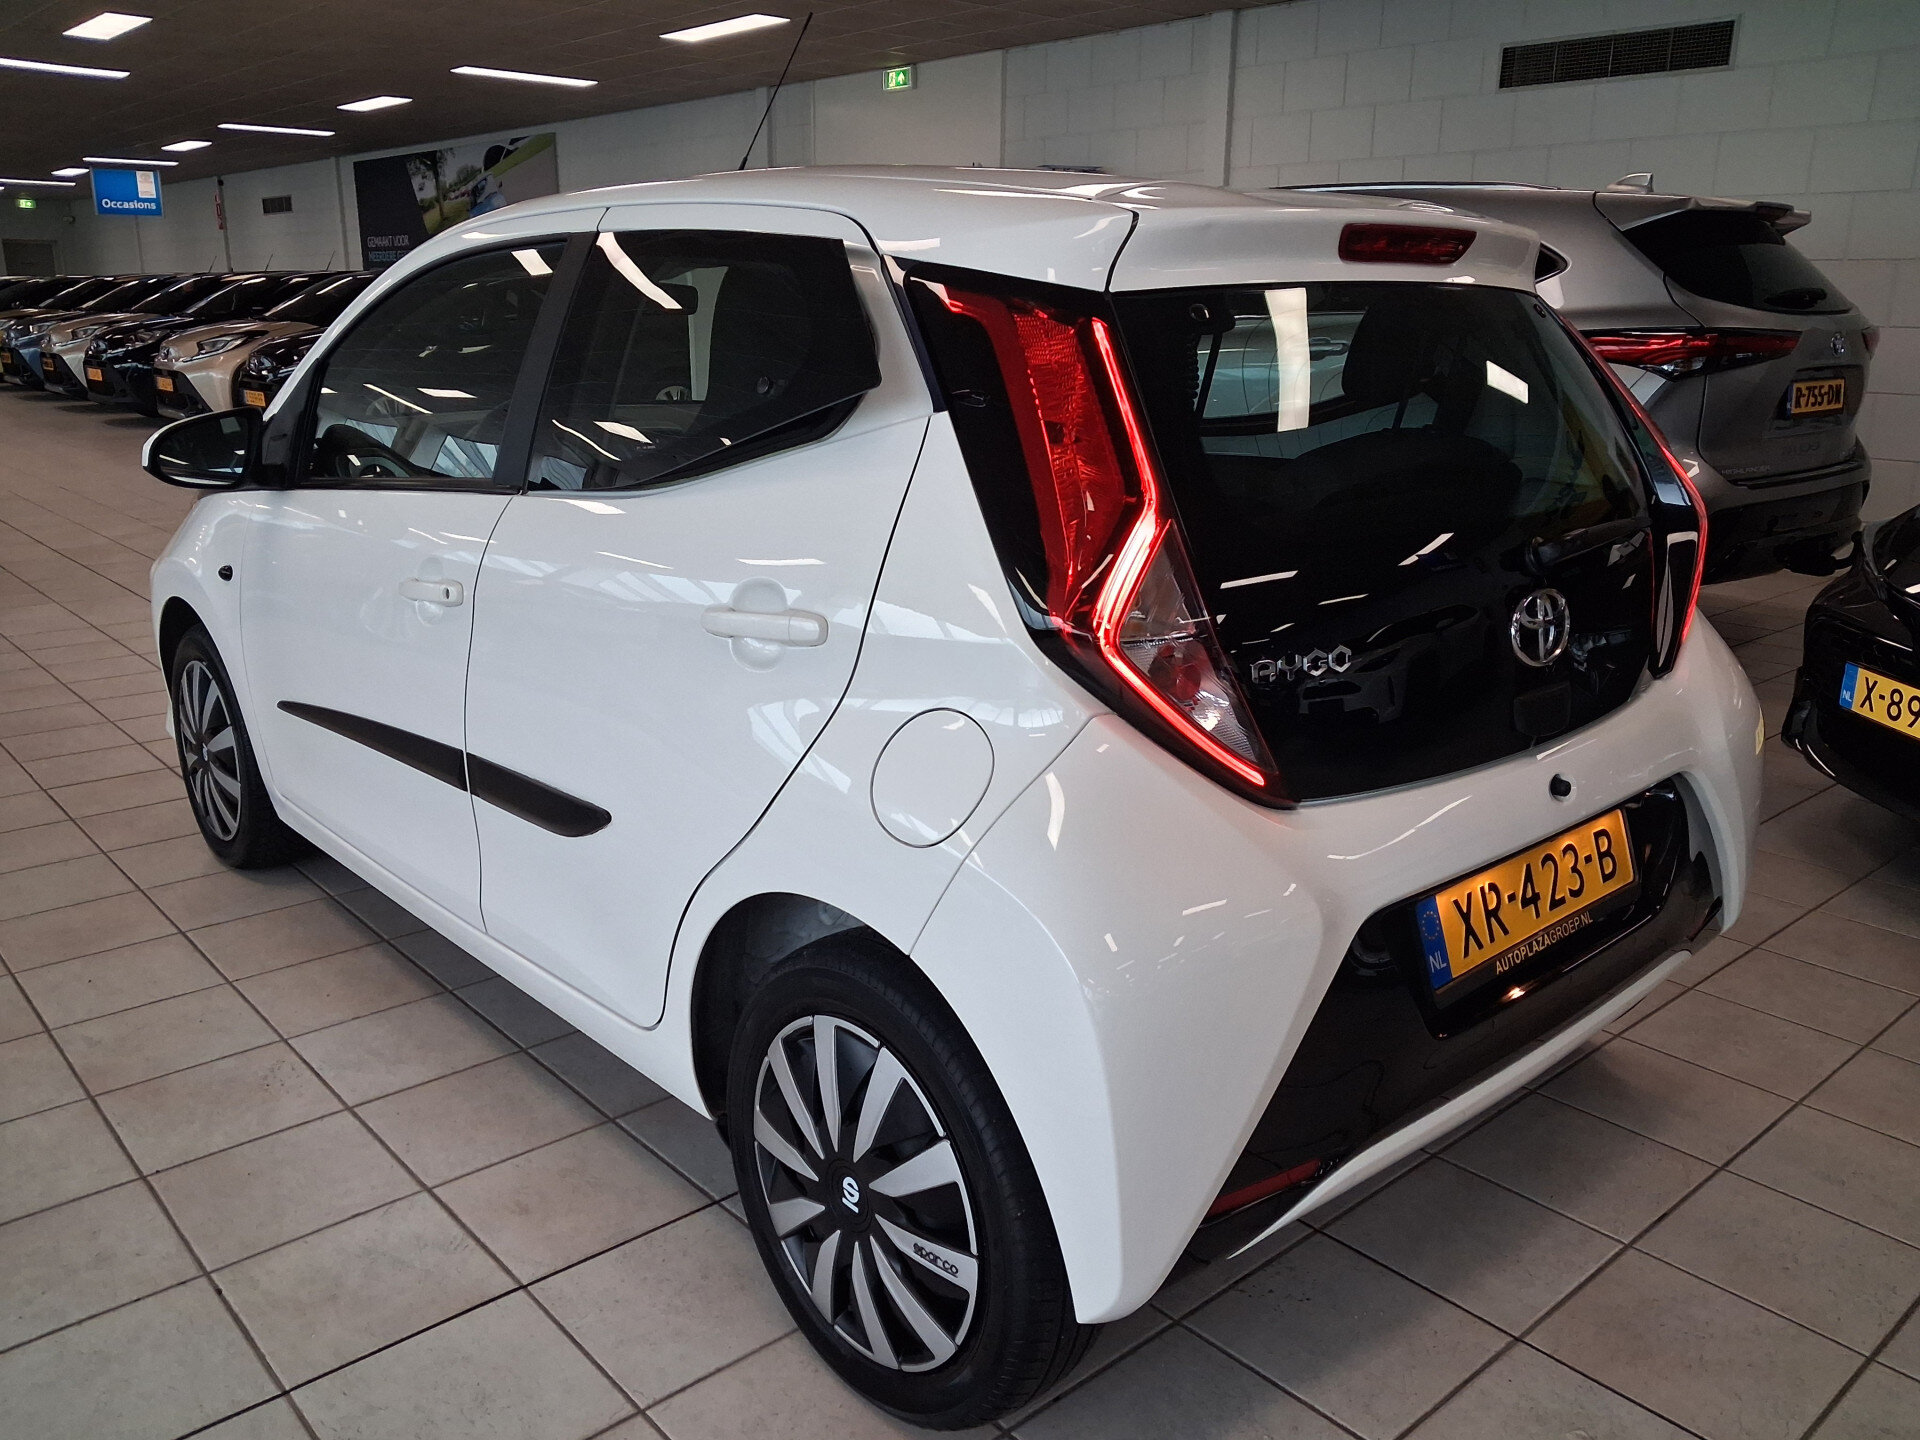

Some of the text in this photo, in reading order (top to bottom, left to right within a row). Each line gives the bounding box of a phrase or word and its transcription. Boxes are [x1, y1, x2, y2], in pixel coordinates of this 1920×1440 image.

[101, 198, 157, 210] Occasions
[1794, 383, 1842, 409] R-755-DN
[1250, 644, 1352, 684] AYGO
[1842, 689, 1853, 702] NL
[1452, 828, 1618, 960] XR-423-B
[1495, 911, 1594, 975] AUTOPLAZAGROEP.NL
[1429, 950, 1447, 974] NL
[912, 1242, 960, 1278] sparco
